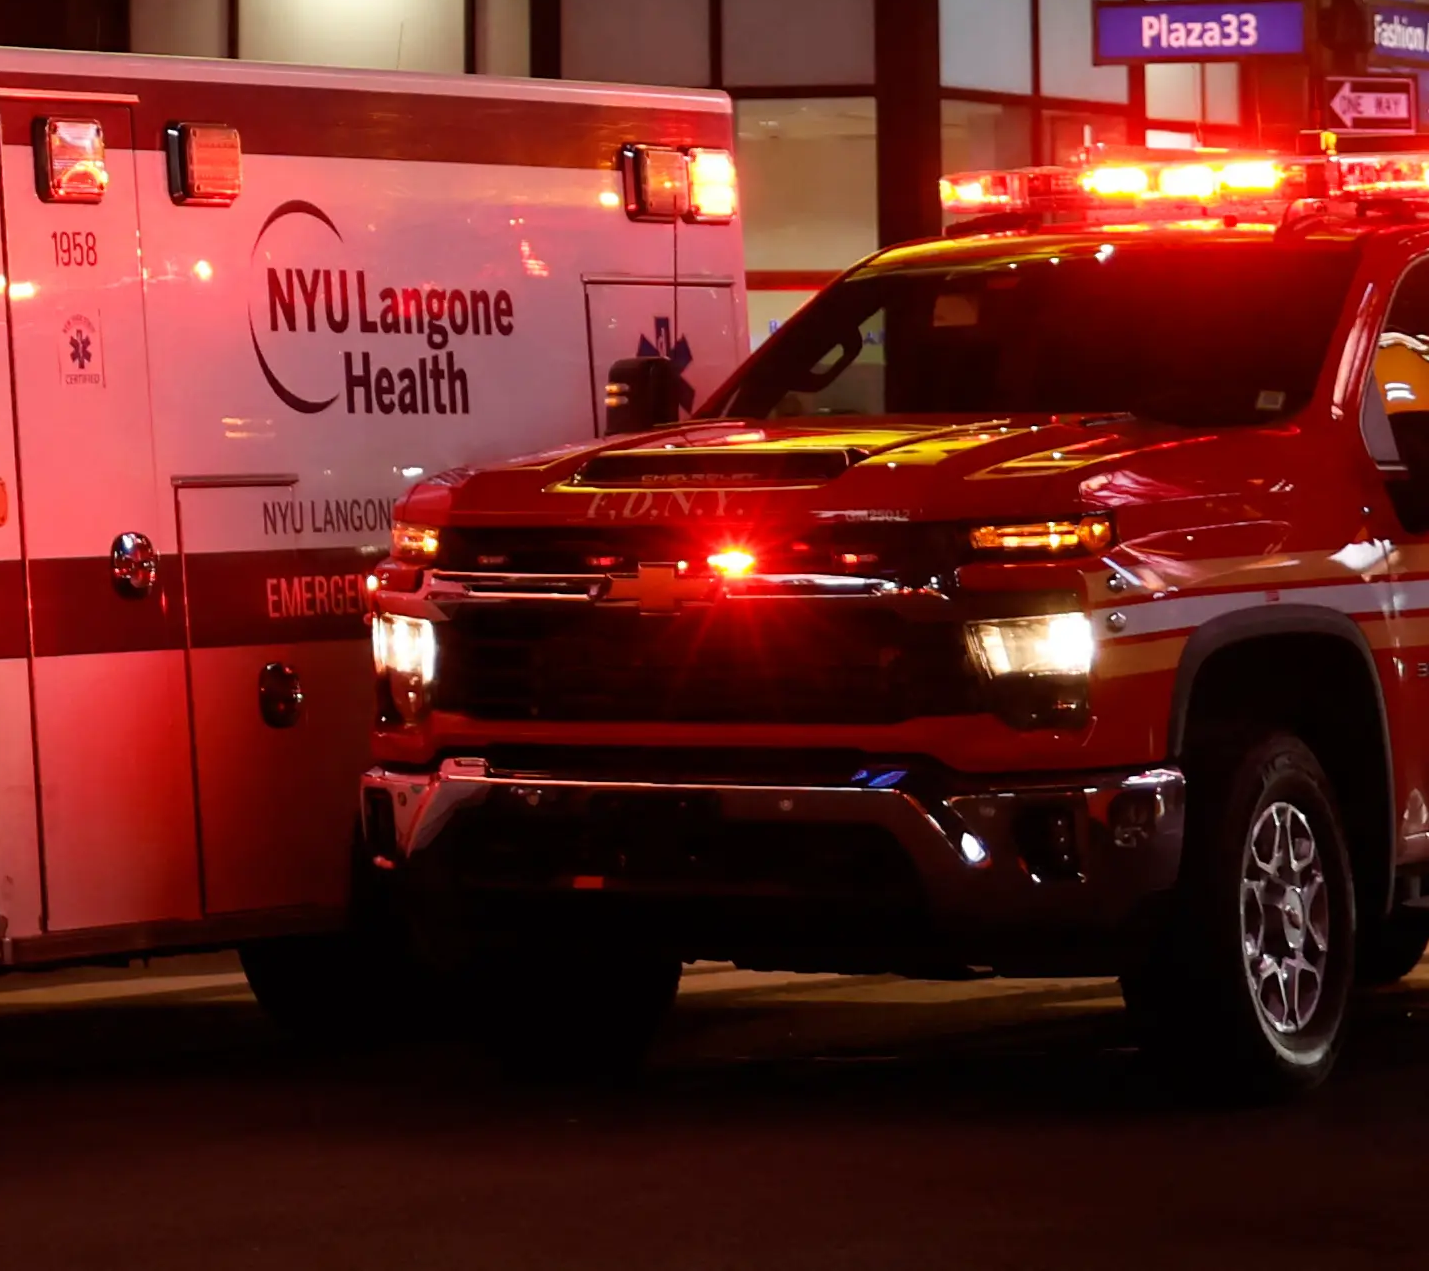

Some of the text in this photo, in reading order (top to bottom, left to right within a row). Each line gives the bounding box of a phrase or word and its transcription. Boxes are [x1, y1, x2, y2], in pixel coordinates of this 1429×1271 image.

[1141, 14, 1259, 49] Plaza33
[1374, 14, 1423, 52] Fashion
[50, 231, 98, 268] 1958
[267, 266, 514, 350] NYU Langone
[344, 349, 471, 417] Health
[263, 500, 304, 536] NYU
[587, 489, 744, 520] F.D.N.Y.
